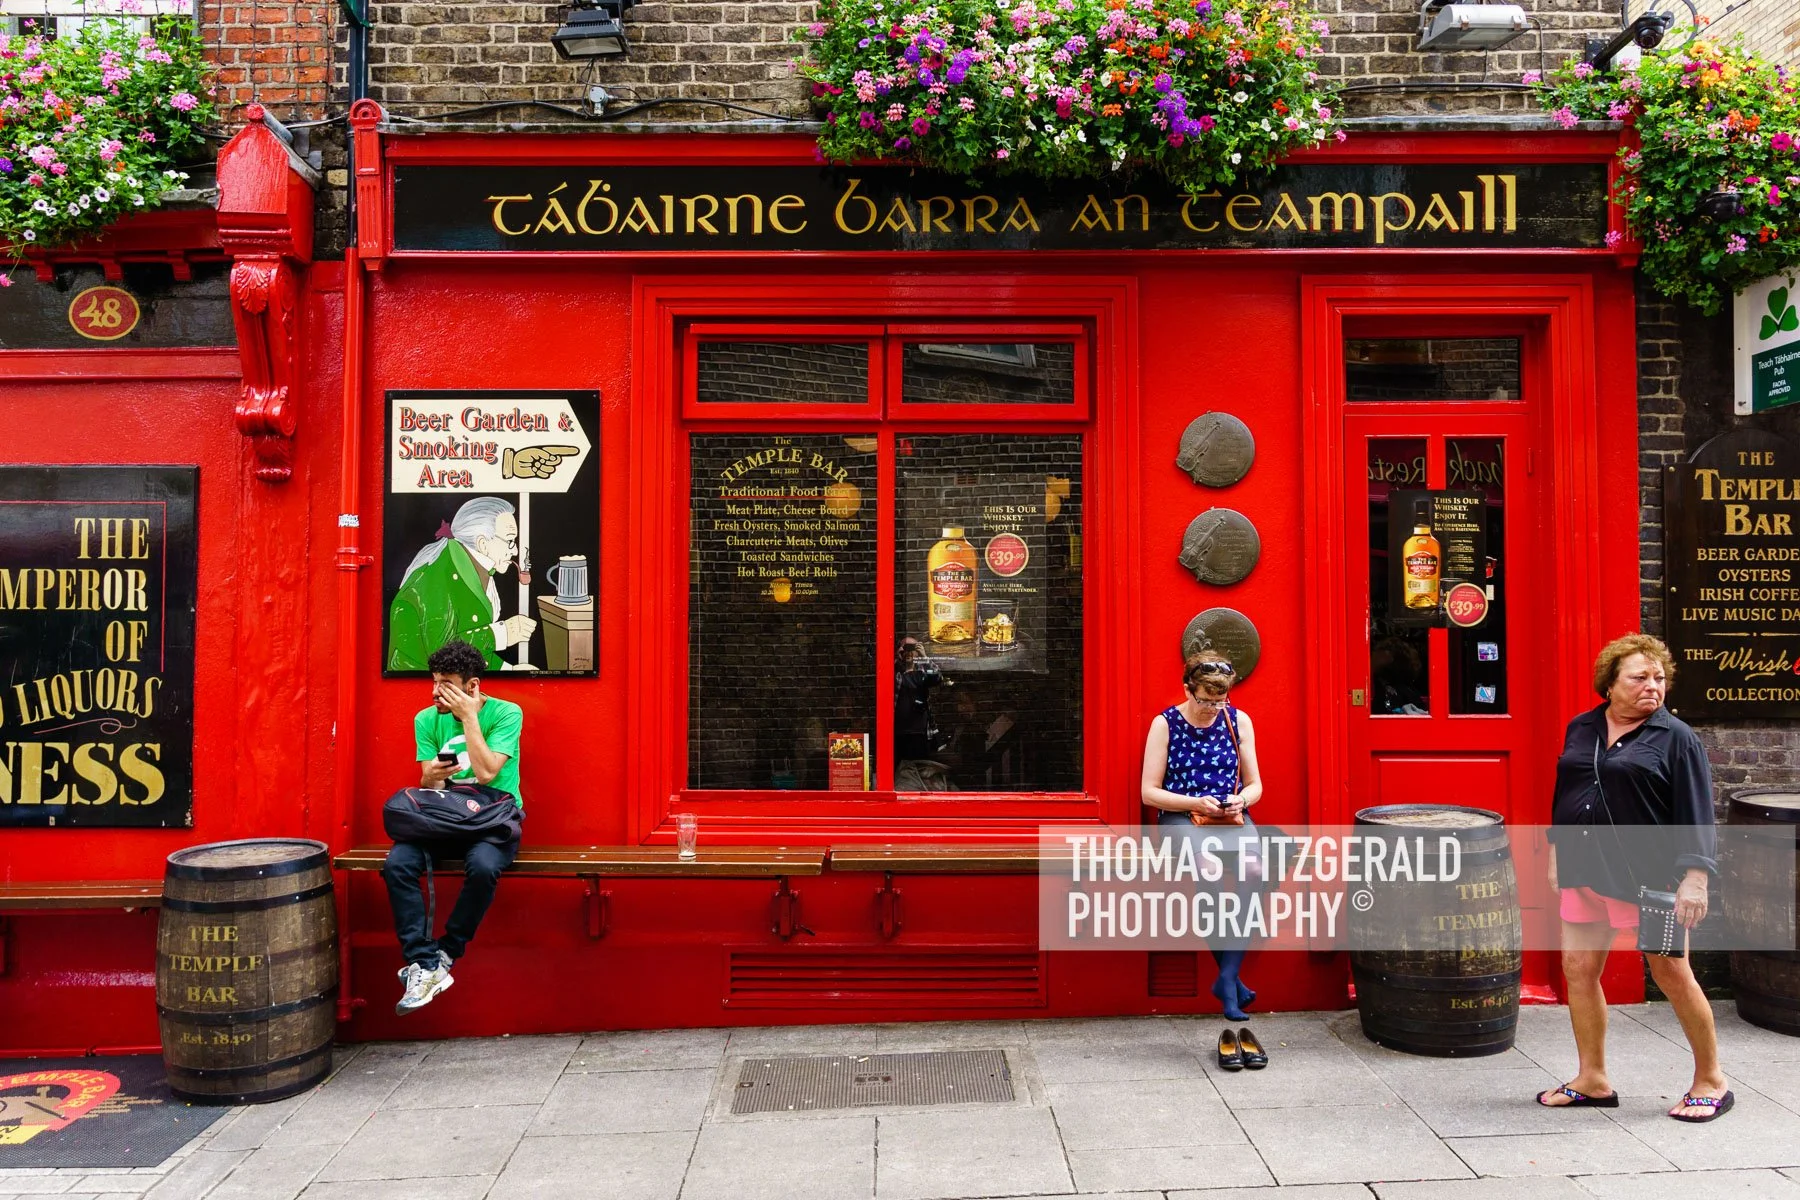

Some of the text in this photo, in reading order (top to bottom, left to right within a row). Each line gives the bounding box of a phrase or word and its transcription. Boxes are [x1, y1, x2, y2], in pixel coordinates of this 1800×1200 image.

[79, 296, 122, 328] 48
[1758, 358, 1773, 369] Teach
[1774, 366, 1784, 376] Pub
[1768, 385, 1791, 397] APPROVED
[398, 406, 575, 432] Beer Garden &
[774, 436, 792, 445] The
[398, 435, 498, 465] Smoking
[1737, 451, 1775, 466] THE
[720, 448, 849, 484] TEMPLE BAR
[784, 467, 799, 475] 1840
[416, 463, 474, 488] Area
[719, 485, 784, 497] Traditional
[790, 485, 818, 497] Food
[1462, 497, 1479, 505] OUR
[726, 504, 848, 517] Meat Plate, Cheese Board
[983, 505, 1037, 514] THIS IS OUR
[1434, 504, 1469, 512] WHISKEY.
[714, 520, 740, 531] Fresh
[784, 520, 821, 531] Smoked
[825, 520, 860, 531] Salmon
[1724, 504, 1793, 536] BAR
[983, 524, 1009, 532] ENJOY
[74, 518, 150, 559] THE
[726, 535, 848, 547] Charcuterie Meats, Olives
[740, 551, 834, 562] Toasted Sandwiches
[1697, 548, 1740, 561] BEER
[737, 566, 837, 577] Hot Roast Beef Rolls
[1718, 569, 1791, 581] OYSTERS
[0, 568, 149, 611] MPEROR
[1700, 588, 1744, 601] IRISH
[1450, 600, 1484, 616] €39.99
[1682, 608, 1719, 621] LIVE
[1724, 608, 1776, 621] MUSIC
[105, 620, 148, 662] OF
[1684, 649, 1714, 660] THE
[12, 667, 162, 726] LIQUORS
[1455, 881, 1502, 900] THE
[188, 925, 240, 943] THE
[168, 953, 264, 973] TEMPLE
[186, 985, 239, 1006] BAR
[1451, 994, 1509, 1009] Est. 1840
[182, 1032, 252, 1046] Est. 1840
[0, 1072, 105, 1088] EMPLE
